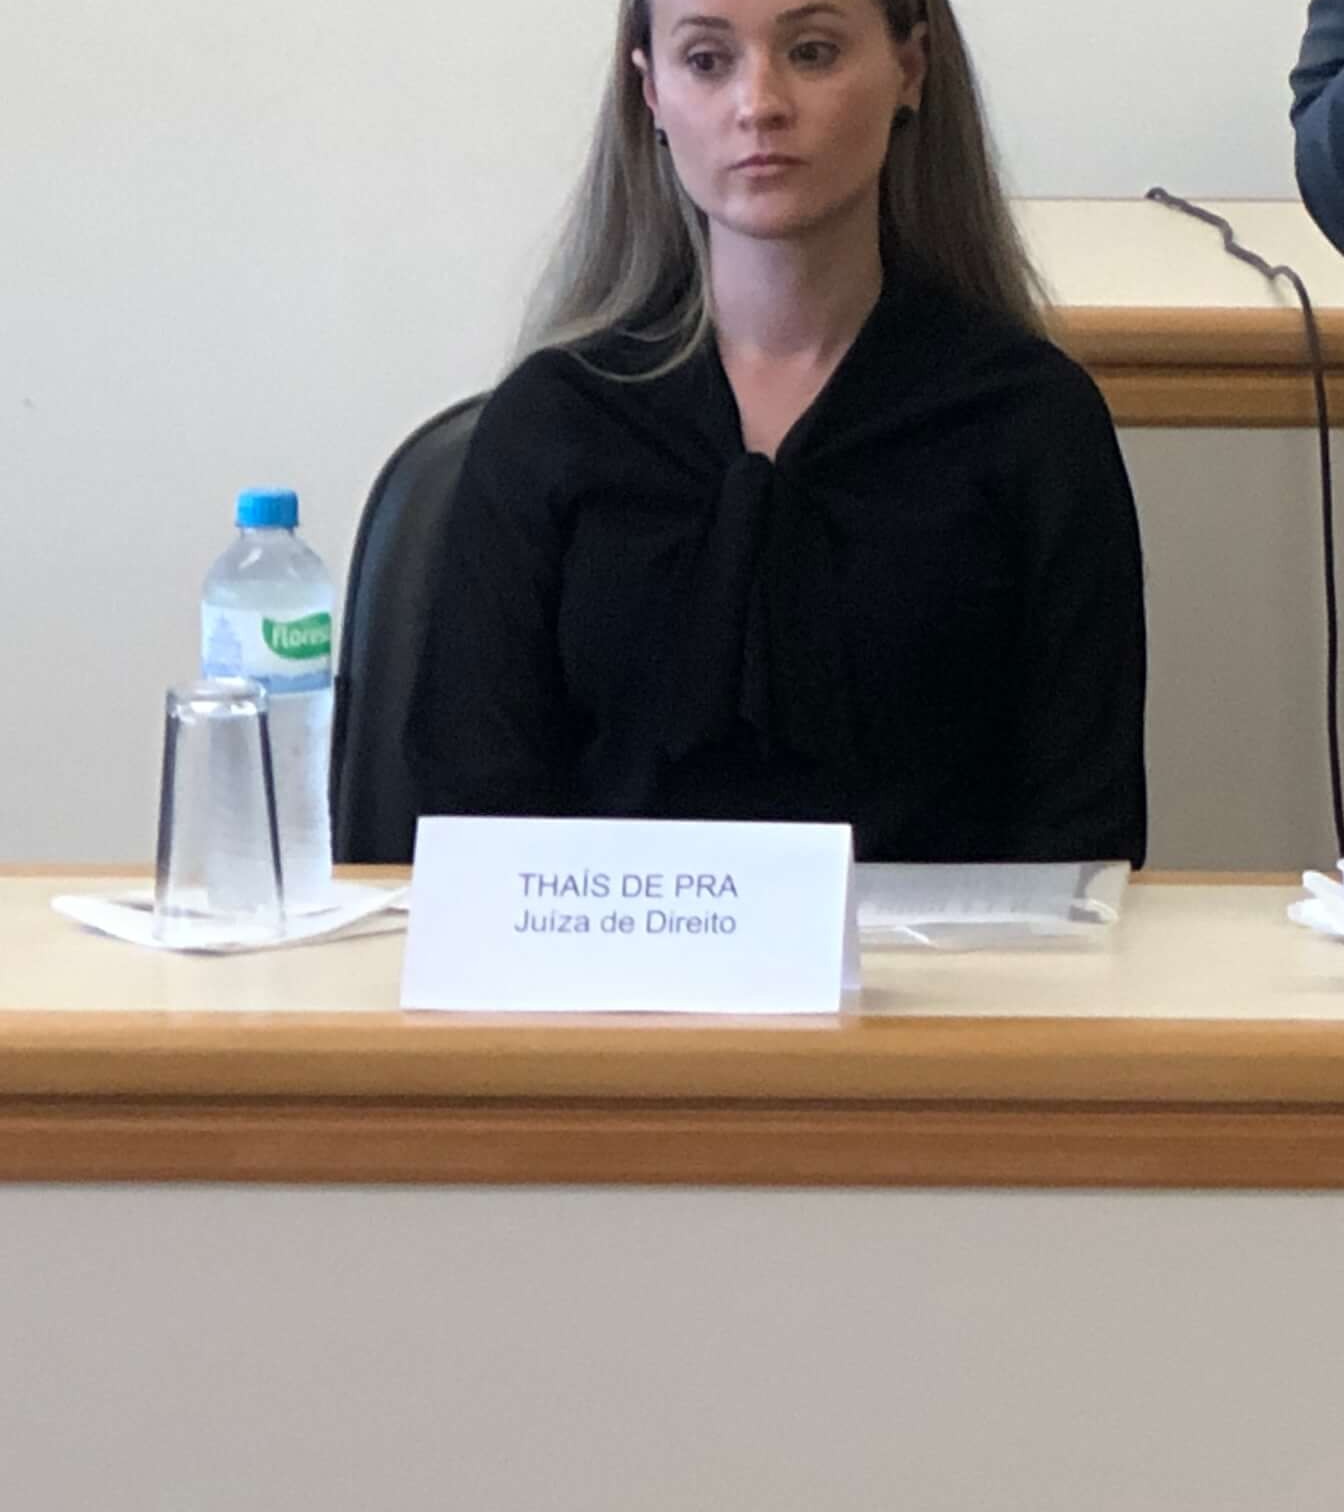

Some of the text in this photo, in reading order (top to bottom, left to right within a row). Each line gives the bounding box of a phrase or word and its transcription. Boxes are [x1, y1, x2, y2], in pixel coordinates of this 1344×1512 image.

[517, 868, 739, 898] THAÍS DE PRA
[600, 910, 636, 934] de
[645, 909, 737, 935] Direito
